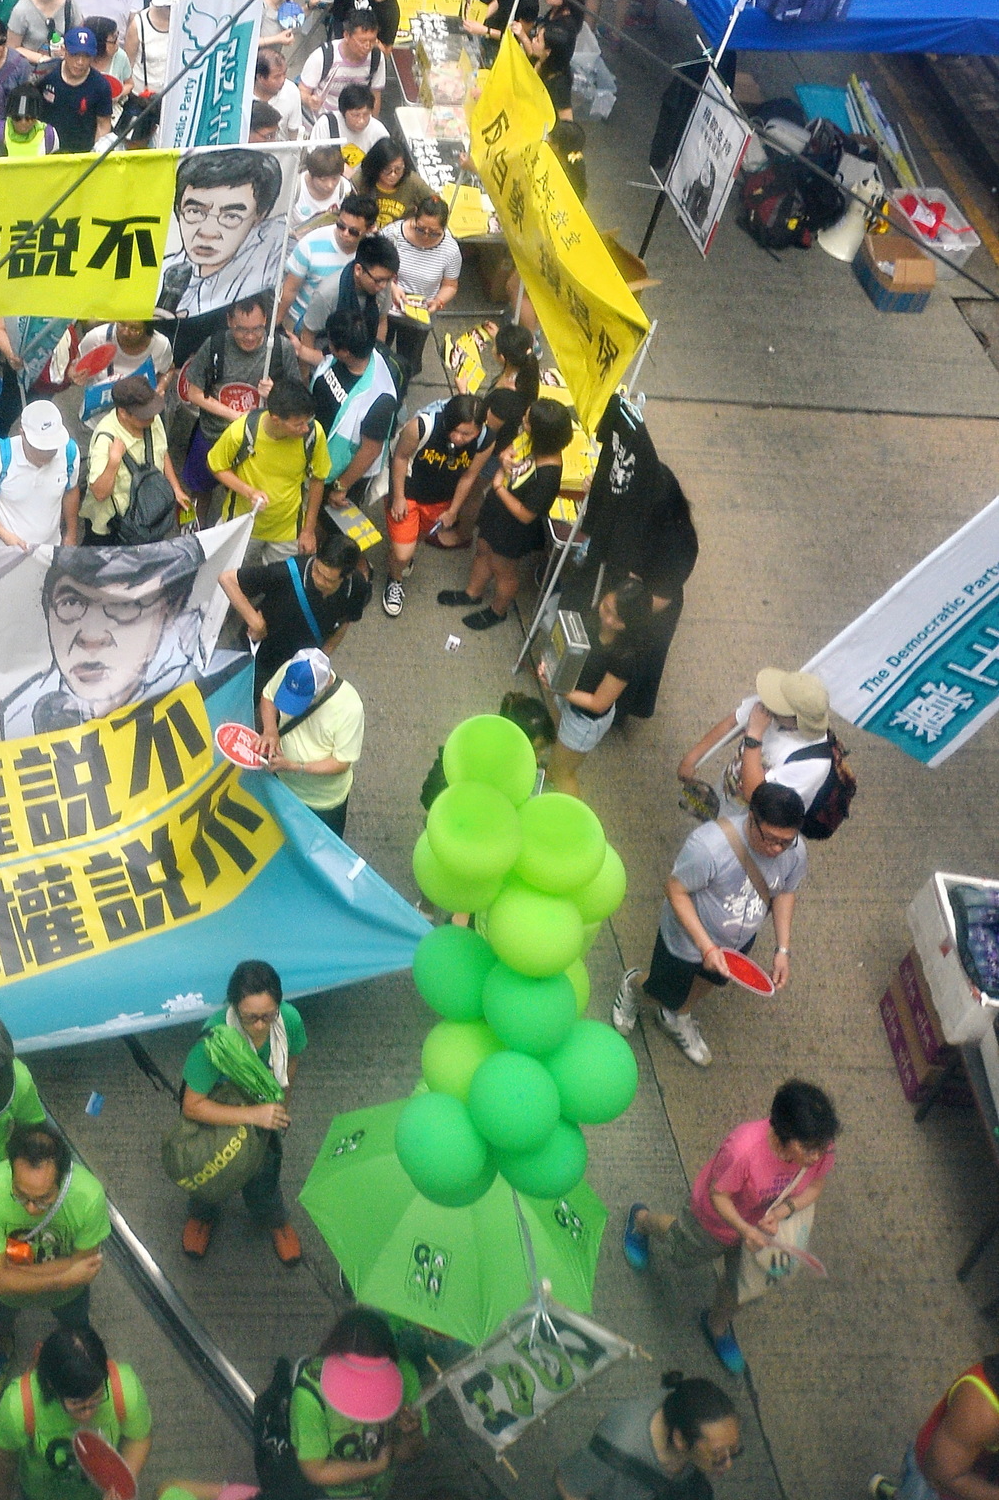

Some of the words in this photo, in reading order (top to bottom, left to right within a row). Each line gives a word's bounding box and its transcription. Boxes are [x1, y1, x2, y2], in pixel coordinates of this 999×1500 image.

[859, 666, 891, 695] The
[887, 596, 966, 669] Democratic
[192, 1134, 242, 1187] adidas
